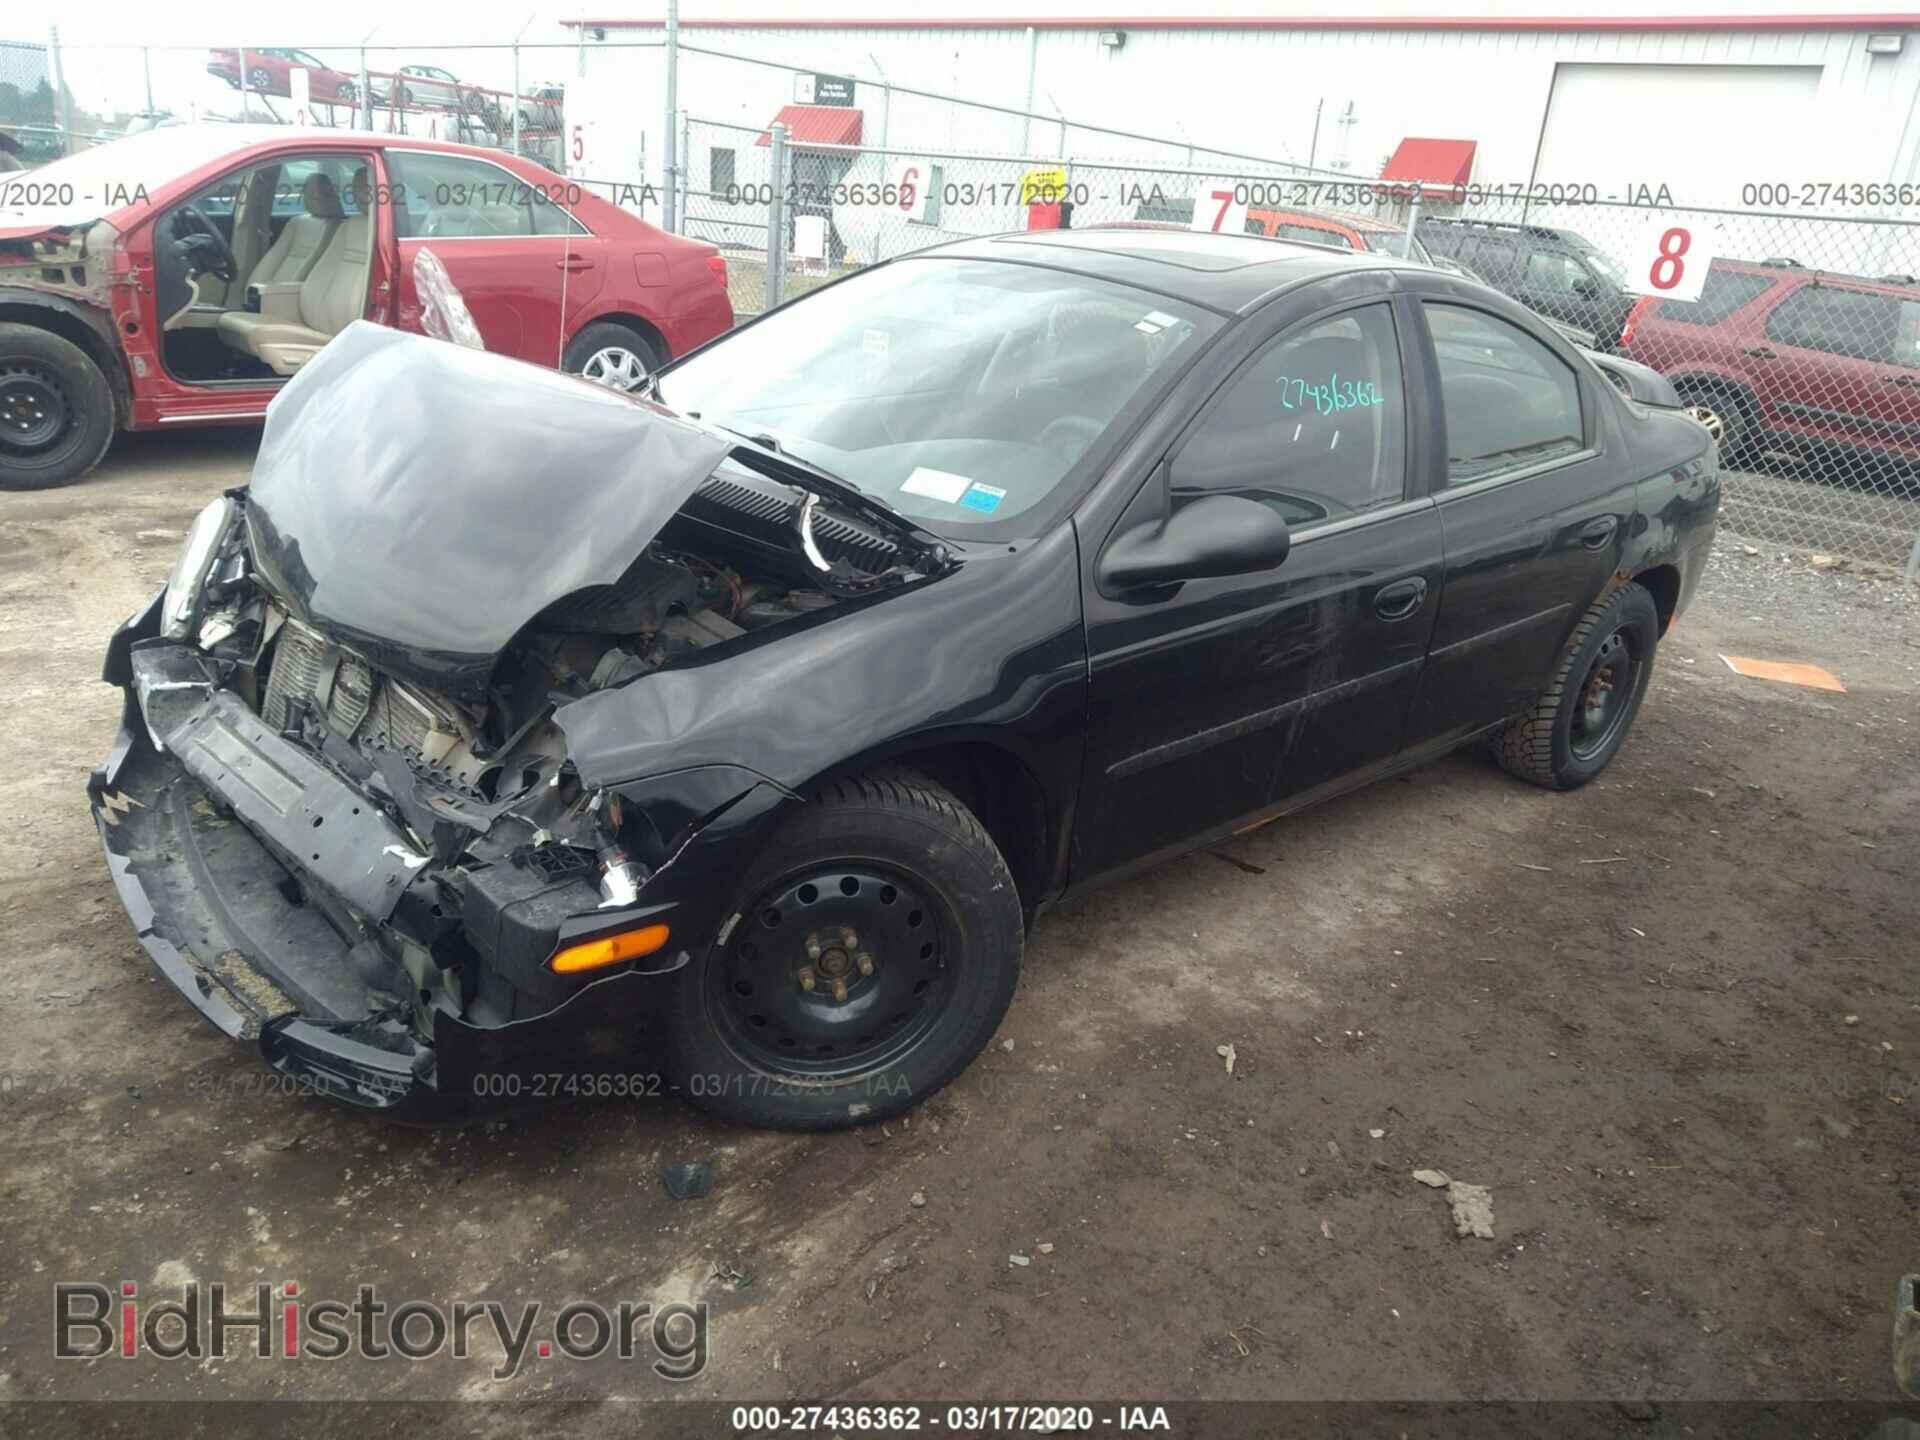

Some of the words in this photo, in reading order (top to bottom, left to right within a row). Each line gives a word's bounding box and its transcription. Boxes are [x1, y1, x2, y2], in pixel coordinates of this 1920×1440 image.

[573, 125, 584, 161] 5
[899, 167, 919, 212] 6
[1211, 191, 1234, 232] 7
[1650, 227, 1692, 290] 8
[1275, 373, 1385, 416] 27436362
